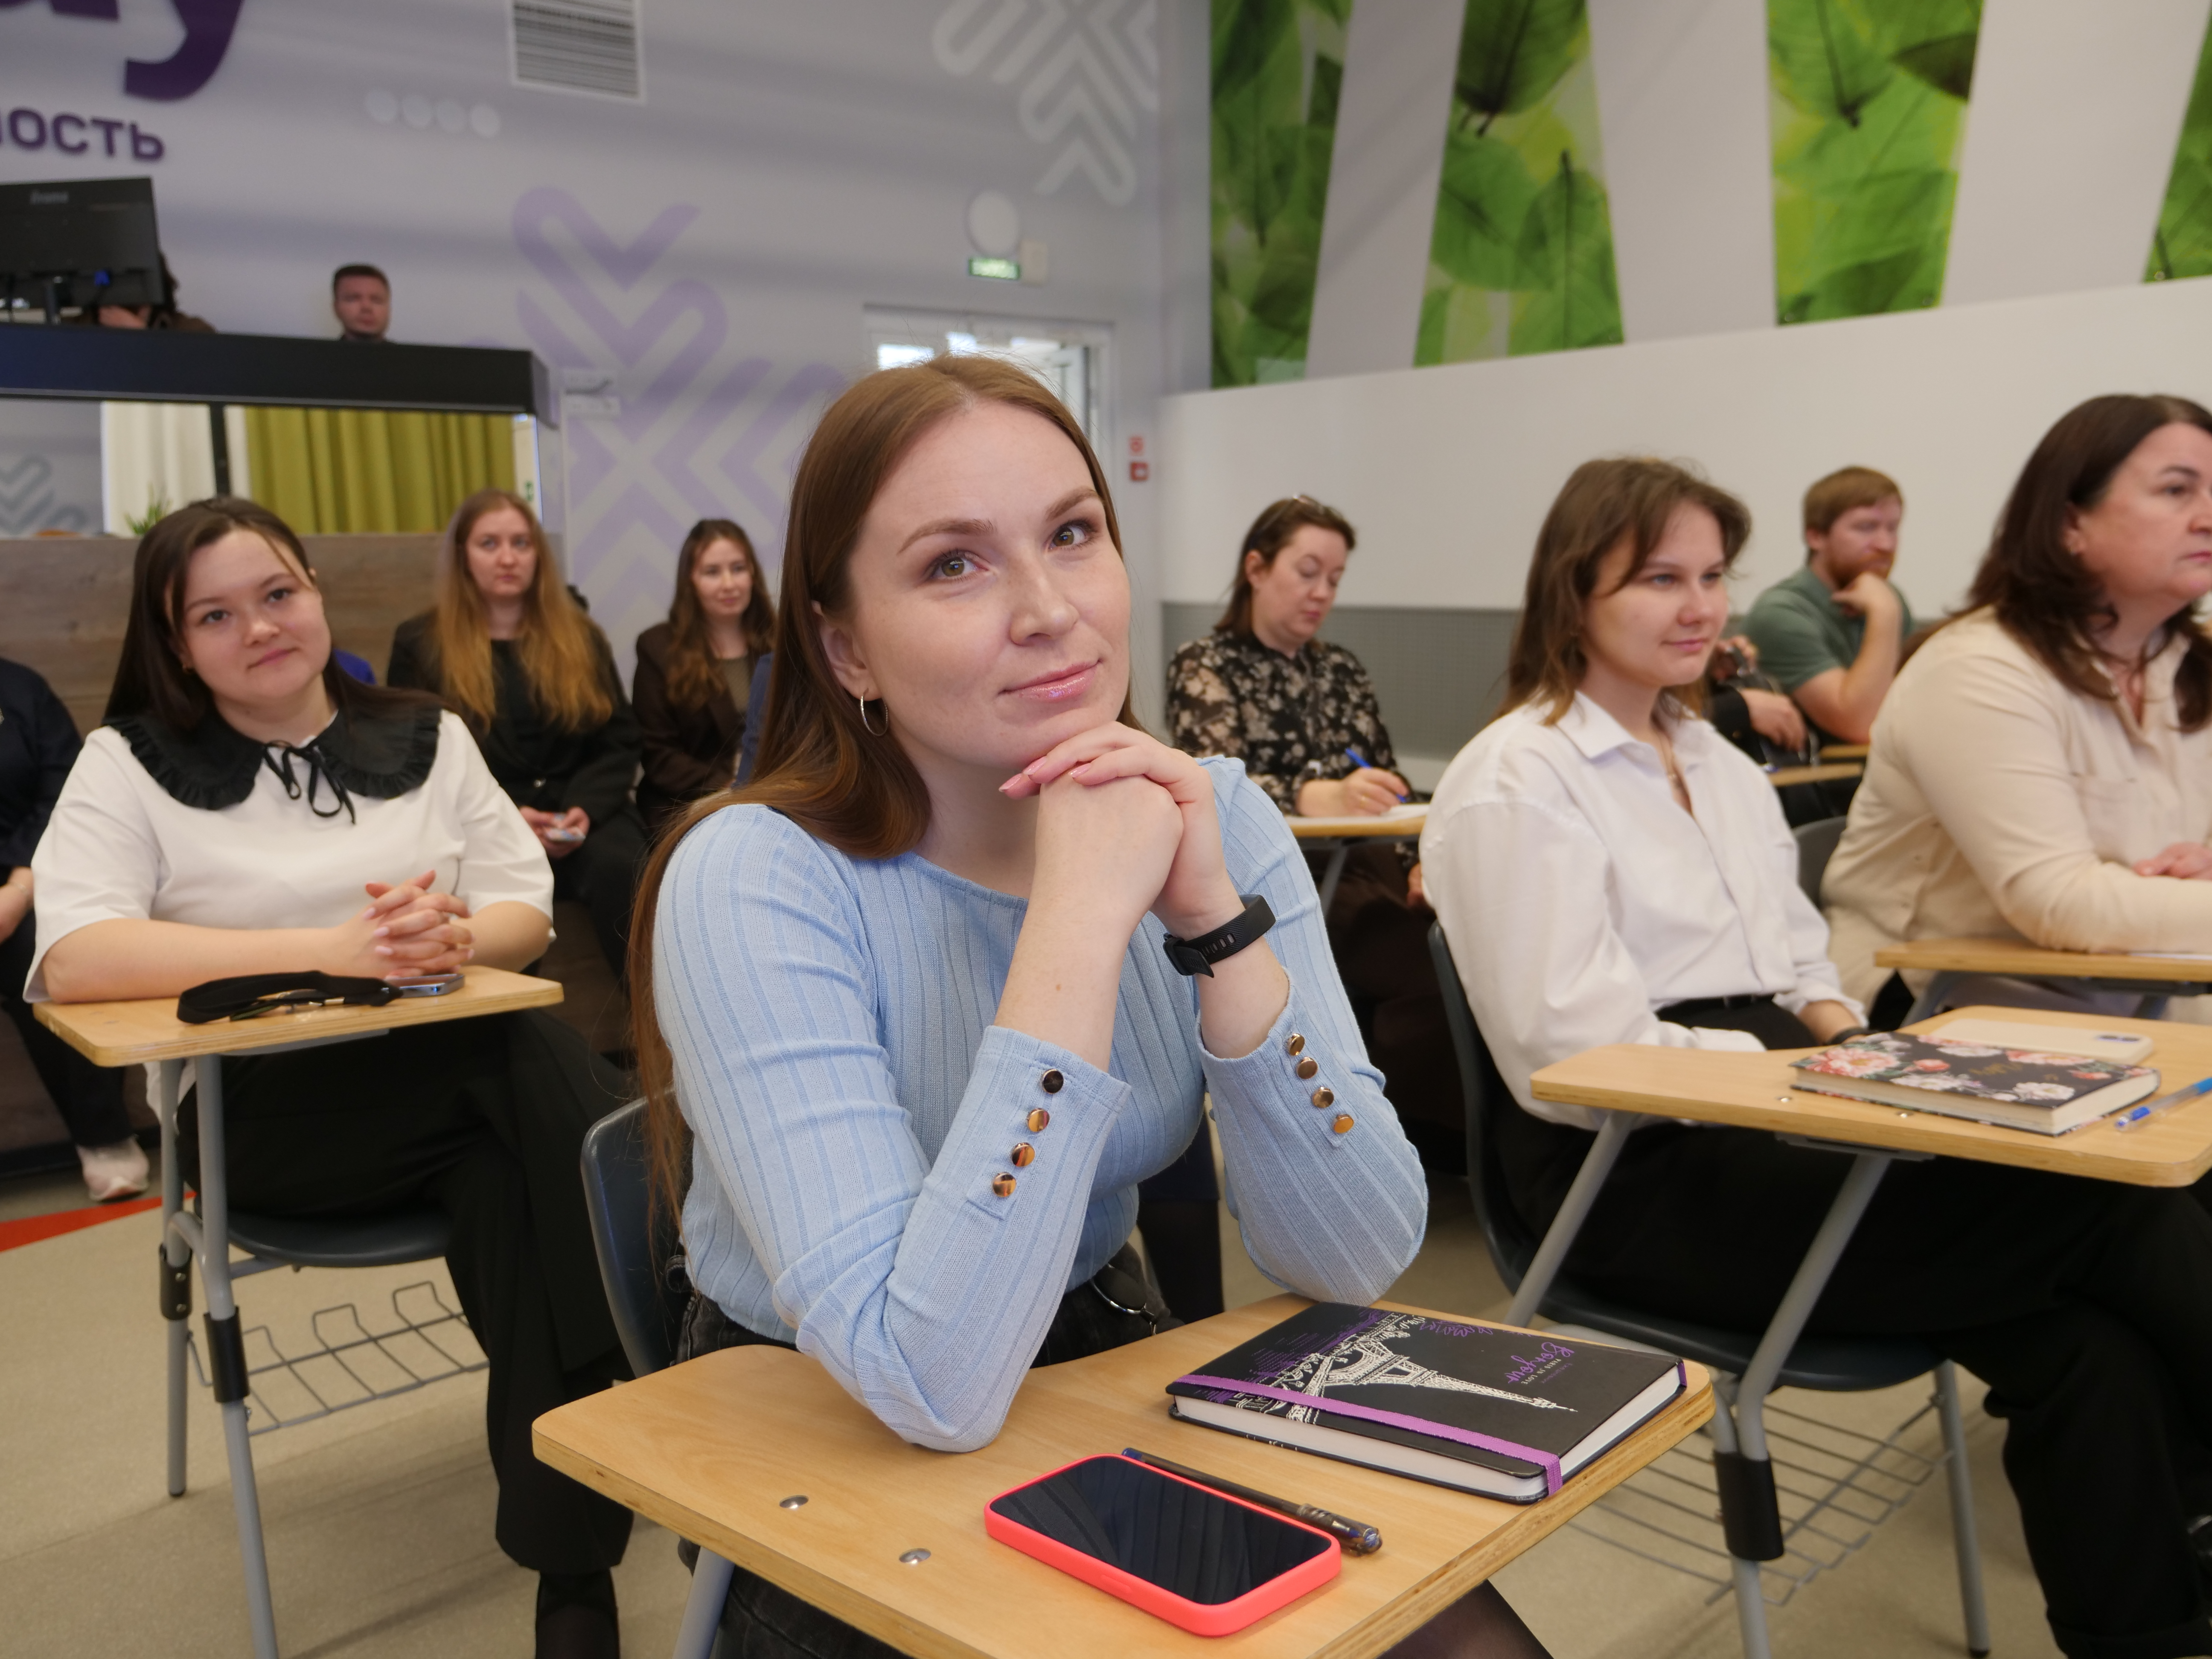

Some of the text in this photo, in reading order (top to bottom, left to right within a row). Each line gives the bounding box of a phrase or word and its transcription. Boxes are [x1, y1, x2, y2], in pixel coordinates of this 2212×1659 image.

[1505, 1342, 1575, 1384] Bonjour
[1544, 1358, 1561, 1369] PARIS
[1521, 1374, 1538, 1385] LOVE
